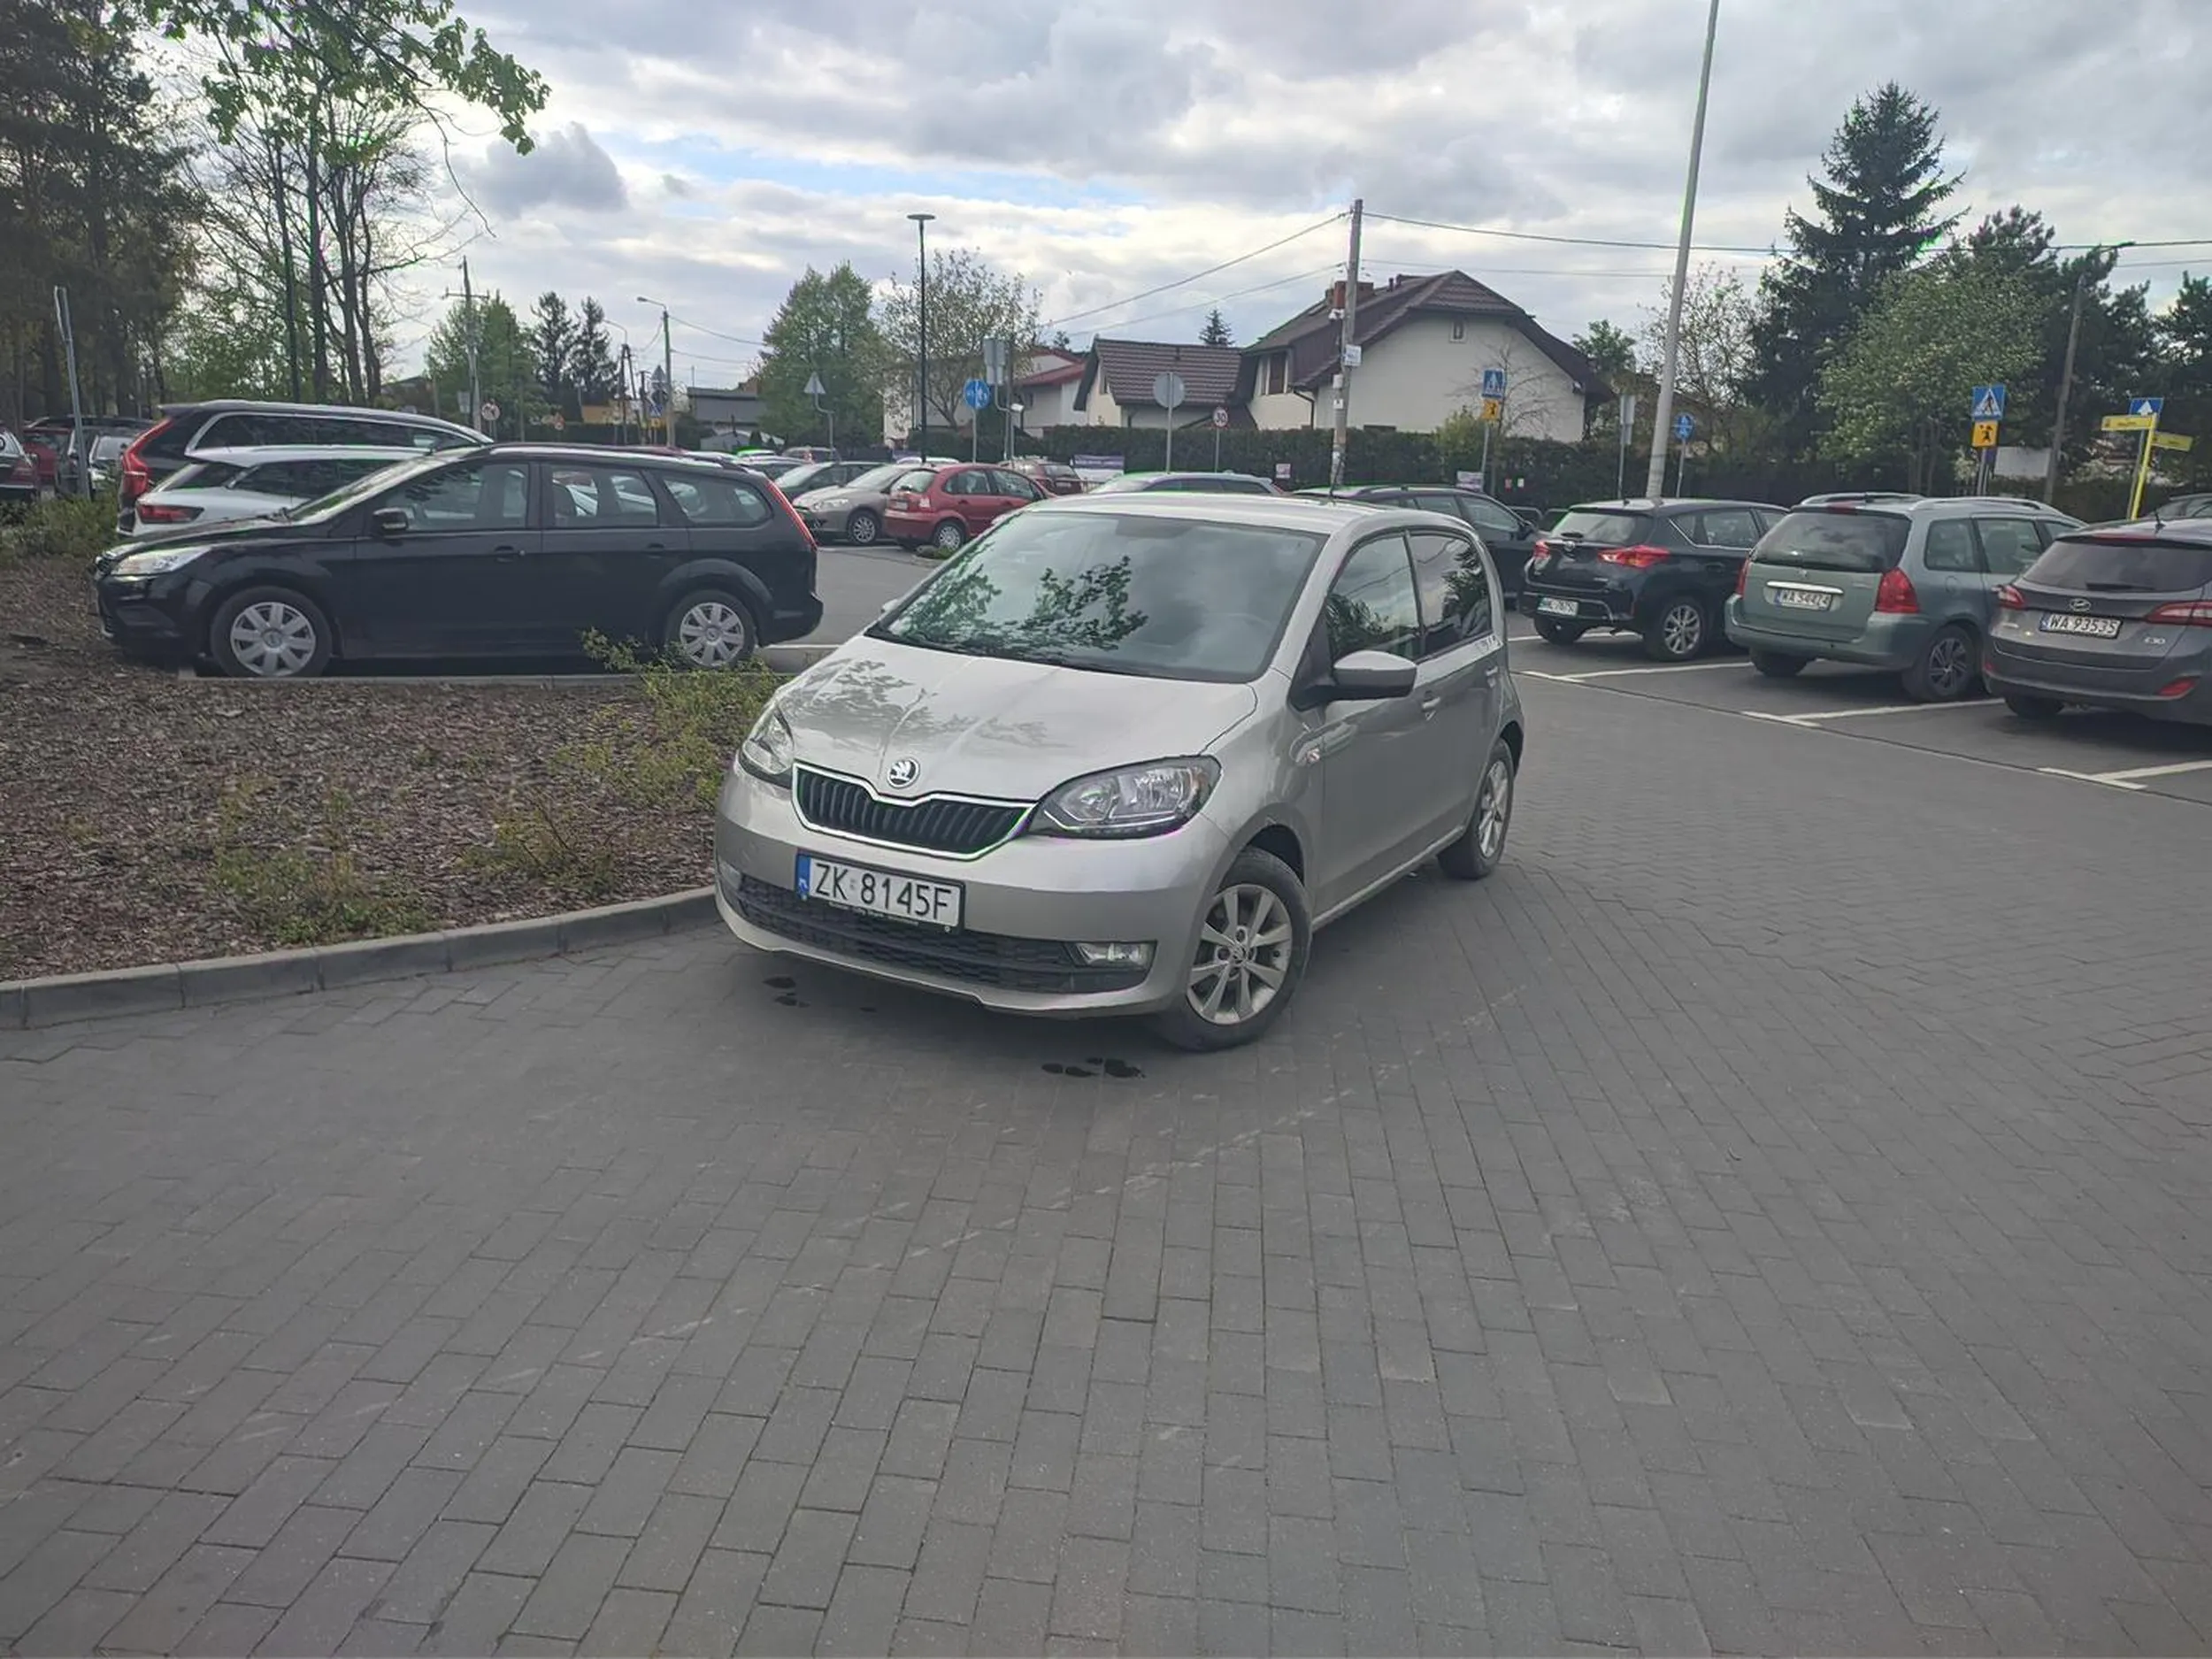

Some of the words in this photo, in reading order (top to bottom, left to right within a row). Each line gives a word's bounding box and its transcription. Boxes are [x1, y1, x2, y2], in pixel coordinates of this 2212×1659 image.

[1216, 412, 1226, 423] 30
[2049, 614, 2069, 628] WA
[2075, 618, 2117, 634] 93535
[816, 862, 849, 901] ZK
[860, 872, 952, 920] 8145F
